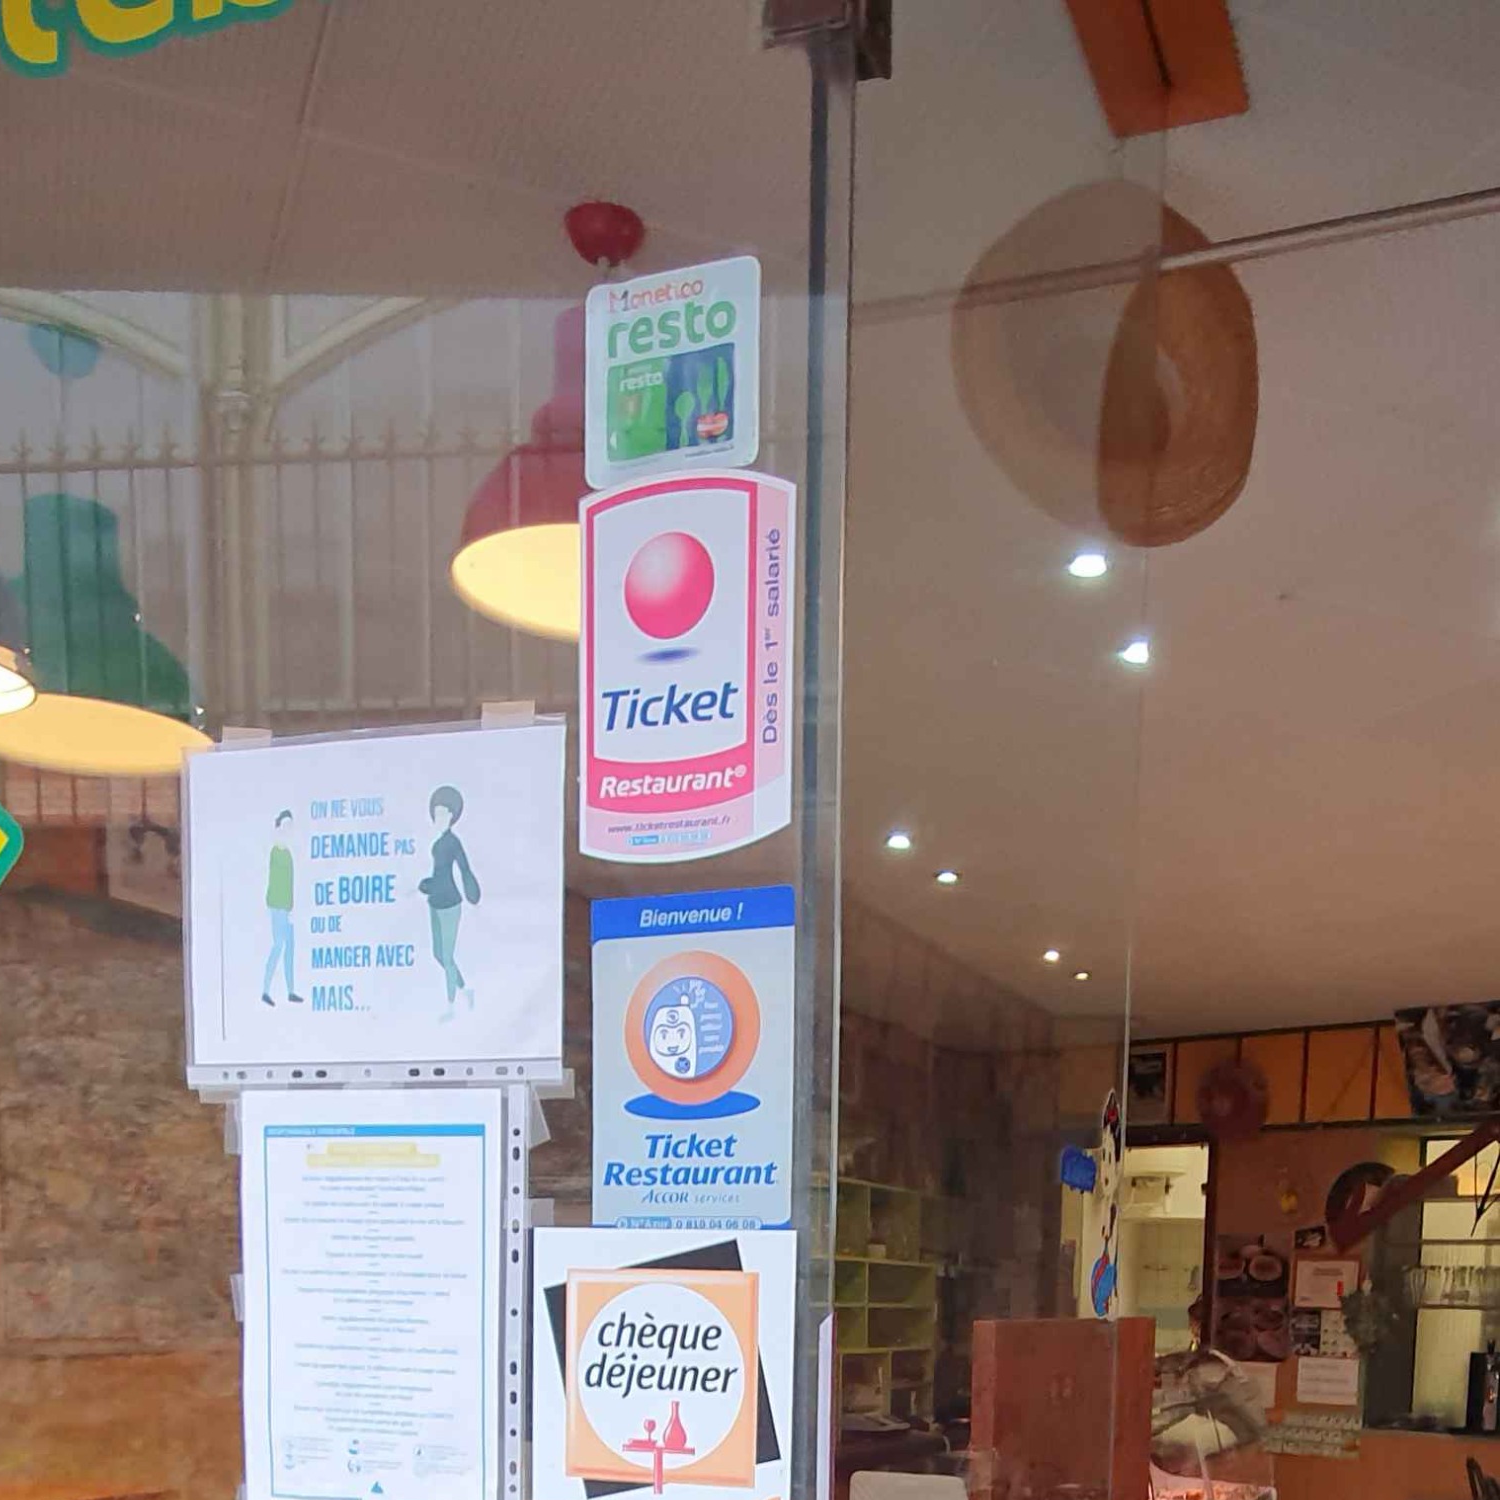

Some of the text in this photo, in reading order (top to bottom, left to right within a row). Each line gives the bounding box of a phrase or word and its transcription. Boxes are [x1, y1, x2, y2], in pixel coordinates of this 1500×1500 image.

[607, 300, 737, 359] resto
[765, 528, 781, 618] salarié
[763, 661, 779, 684] le
[601, 680, 739, 732] Ticket
[762, 691, 779, 744] Dès
[310, 797, 384, 820] ON NE VOUS
[310, 832, 415, 859] DEMANDE PAS
[314, 874, 397, 906] DE BOIRE
[311, 915, 342, 933] OU DE
[639, 906, 732, 928] Bienvenue
[311, 944, 414, 969] MANGER AVEC
[644, 1131, 738, 1159] Ticket
[603, 1161, 778, 1187] Restaurant
[597, 1311, 722, 1359] chèque
[585, 1353, 739, 1398] déjeuner
